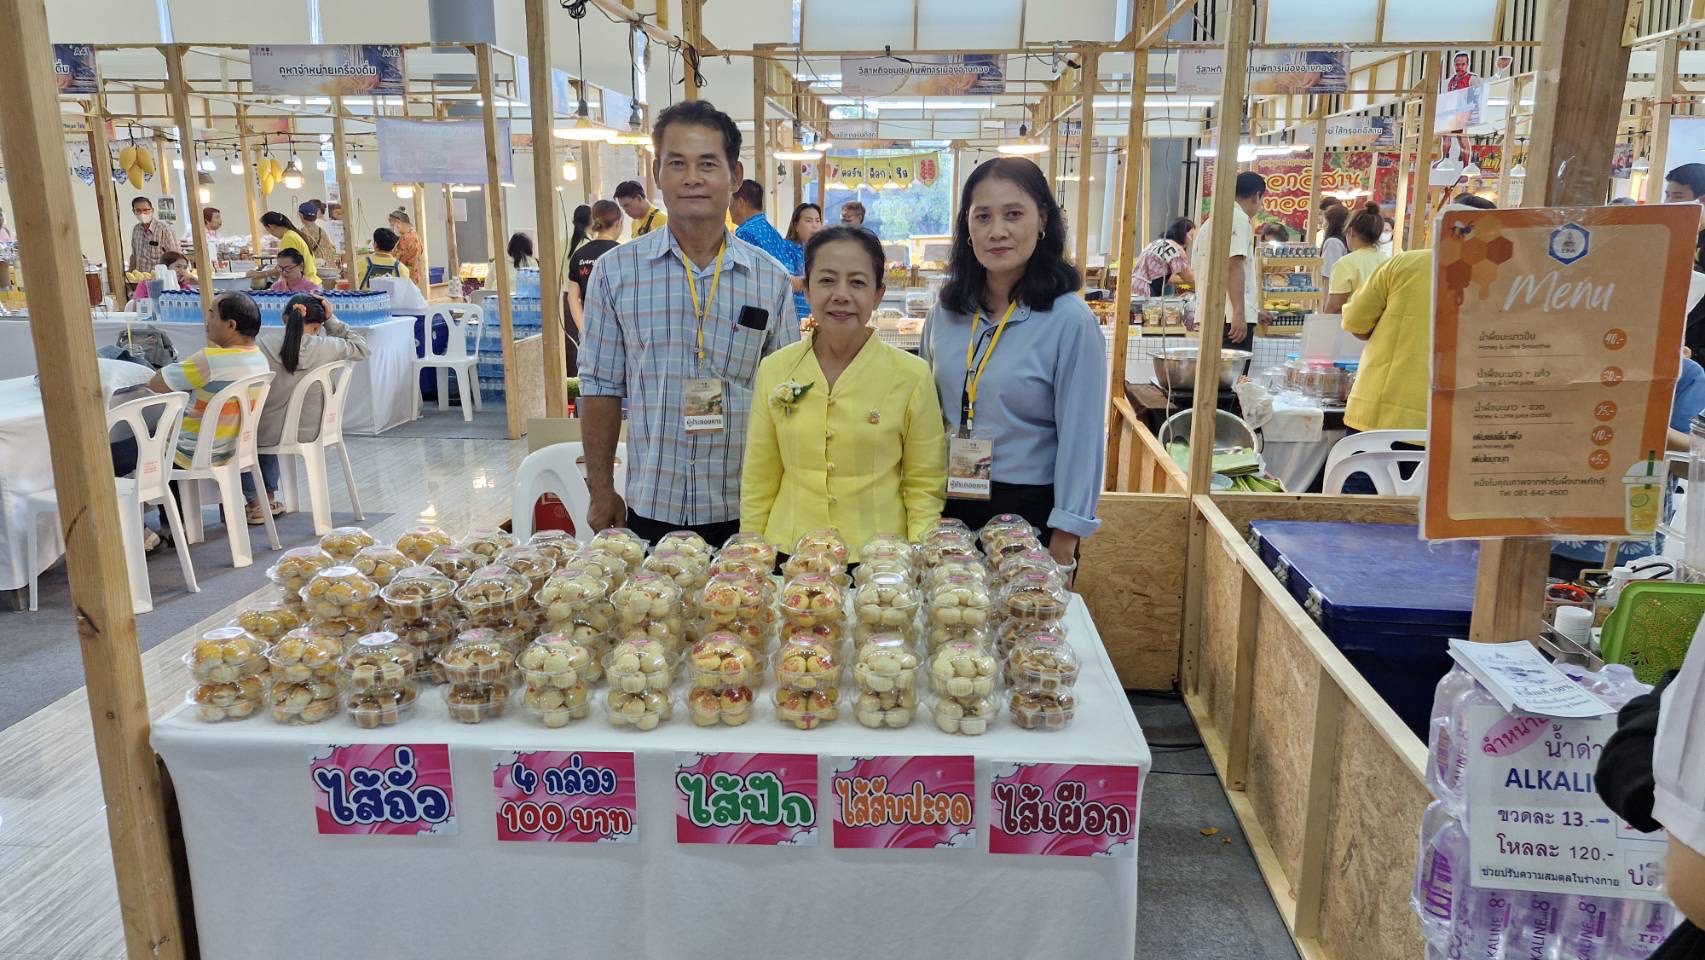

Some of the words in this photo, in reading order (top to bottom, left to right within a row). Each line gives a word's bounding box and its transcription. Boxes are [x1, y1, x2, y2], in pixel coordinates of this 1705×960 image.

[279, 60, 377, 79] คูหาจำหน่ายเครื่องดื่ม
[382, 48, 401, 58] A42
[1503, 271, 1616, 313] Menu
[1545, 723, 1603, 760] น้ำด่า
[313, 746, 449, 825] ไส้ถั่ว
[511, 762, 539, 795] 4
[543, 753, 618, 795] กล่อง
[1505, 767, 1597, 793] ALKALI
[676, 771, 817, 827] ไส้ฟัก
[832, 776, 973, 828] ไส้สับปะรด
[995, 780, 1132, 836] ไส้เผือก
[501, 801, 566, 834] 100
[571, 806, 632, 836] บาท
[1498, 809, 1555, 826] ขวดละ
[1496, 833, 1560, 858] โหลละ
[1569, 846, 1614, 861] 120.-
[1481, 866, 1620, 887] ช่วยปรับความสมดุลในร่างกาย
